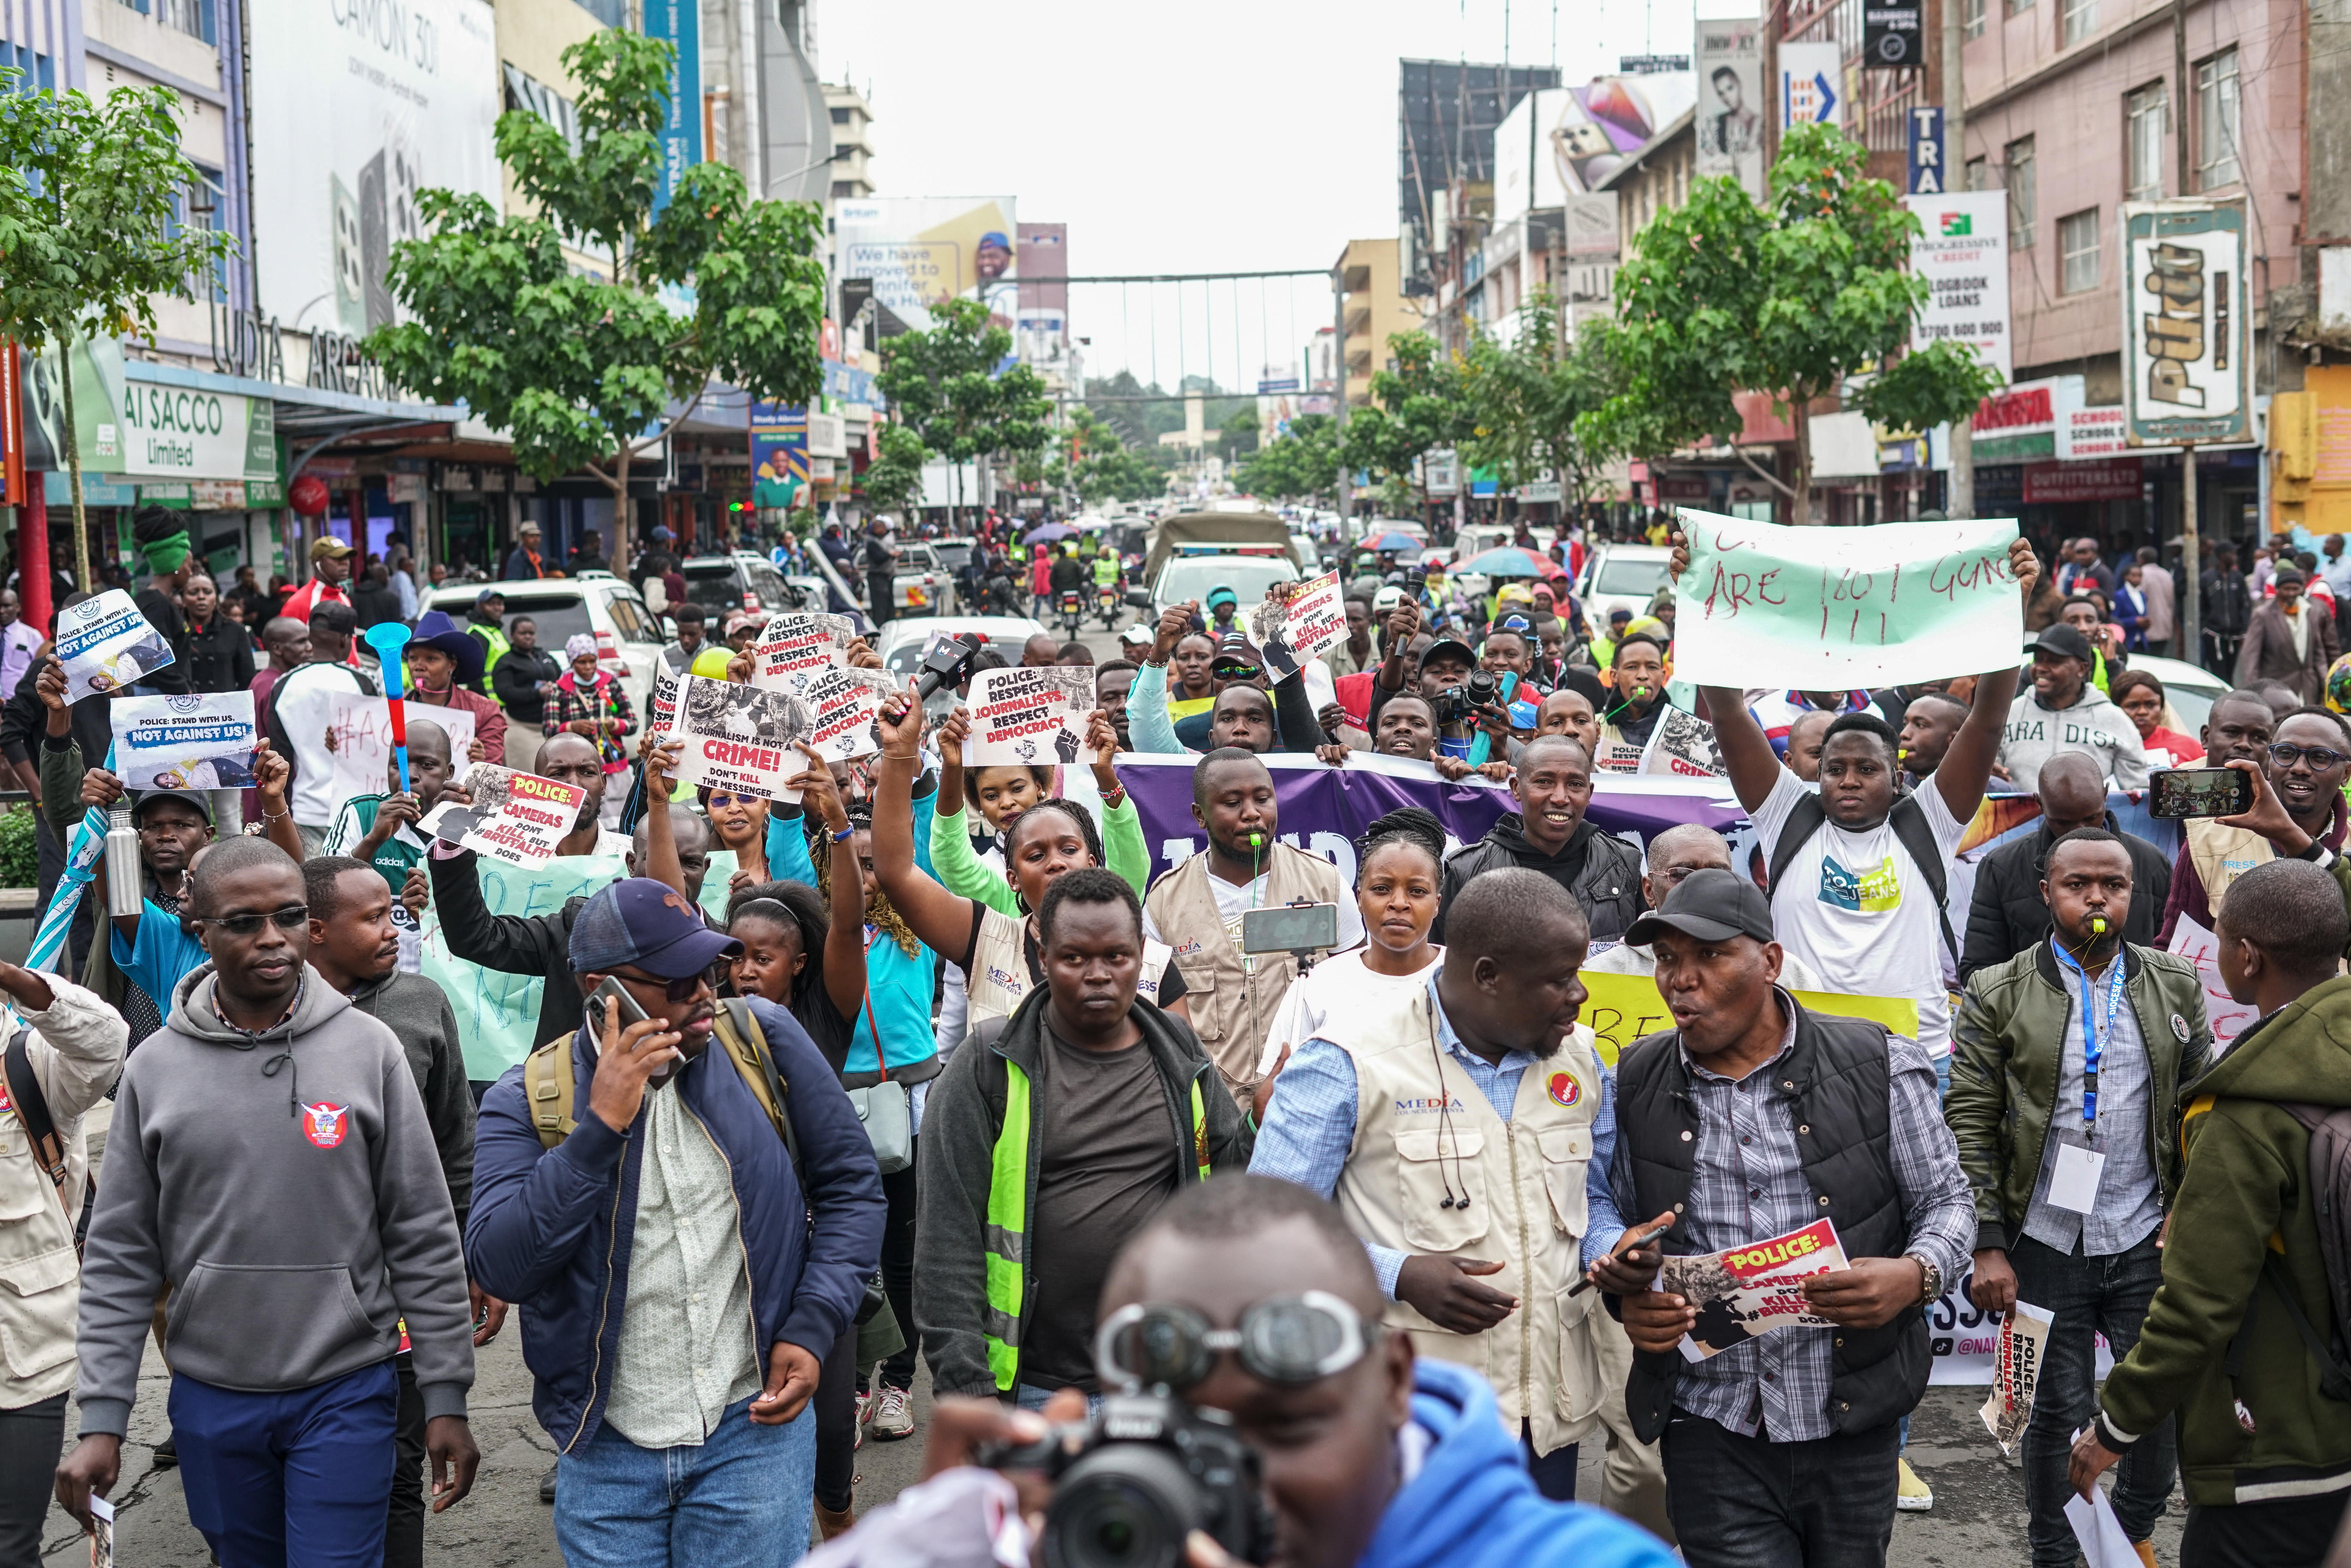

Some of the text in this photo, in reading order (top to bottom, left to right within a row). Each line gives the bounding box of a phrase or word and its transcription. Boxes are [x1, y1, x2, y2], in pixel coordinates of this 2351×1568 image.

[855, 248, 931, 262] We have
[855, 263, 939, 277] moved to
[875, 277, 929, 291] nnifer
[1929, 276, 1989, 293] LOGBOOK
[1939, 294, 1980, 309] LOANS
[150, 388, 223, 436] SACCO
[2071, 410, 2123, 424] SCHOOL
[2071, 427, 2115, 439] SCHOOL
[147, 437, 193, 468] Limited
[2032, 471, 2112, 487] OUTFITTERS
[1704, 560, 1786, 620] ARE
[1287, 593, 1333, 622] CAMERAS
[1303, 609, 1323, 625] DONT
[58, 628, 83, 641] POLICE:
[83, 618, 104, 631] STAND
[104, 610, 123, 622] WITH
[768, 615, 809, 631] POLICE:
[1321, 612, 1335, 626] BUT
[56, 612, 145, 656] NOT AGAINST US!
[768, 623, 816, 642] RESPECT
[1290, 615, 1346, 655] #BRUTALITY
[756, 632, 833, 657] JOURNALISTS,
[1313, 638, 1332, 653] DOES
[771, 646, 819, 664] RESPECT
[765, 654, 831, 677] DEMOCRACY
[987, 669, 1037, 690] POLICE:
[988, 680, 1045, 703] RESPECT
[974, 690, 1066, 720] JOURNALISTS,
[139, 718, 169, 726] POLICE:
[199, 716, 220, 724] WITH
[991, 706, 1049, 729] RESPECT
[132, 725, 247, 742] NOT AGAINST US!
[692, 725, 792, 752] JOURNALISM IS NOT A
[986, 716, 1065, 744] DEMOCRACY
[2003, 721, 2044, 744] ARA
[703, 739, 782, 773] CRIME!
[1600, 757, 1640, 766] JOURNAL
[1664, 745, 1730, 778] JOURNALISM IS NOT
[709, 767, 760, 784] DON'T KILL
[1671, 758, 1717, 778] CRIM
[512, 775, 572, 803] POLICE:
[702, 776, 772, 798] THE MESSENGER
[503, 802, 564, 828] CAMERAS
[515, 821, 544, 836] DONT
[474, 827, 555, 859] #BRUTALITY
[528, 836, 550, 848] BUT
[375, 856, 405, 867] adidas
[494, 847, 522, 862] DOES
[2222, 860, 2256, 870] PRESS
[1849, 884, 1897, 901] JEANS
[1137, 980, 1157, 992] ESS
[2109, 984, 2121, 1016] DIOCESE
[1562, 1081, 1573, 1101] ajea
[1395, 1108, 1428, 1116] COUNCIL
[1723, 1233, 1821, 1270] POLICE:
[2002, 1318, 2014, 1415] OURNALISTS,
[2013, 1332, 2023, 1400] RESPECT
[2023, 1336, 2035, 1395] POLICE:
